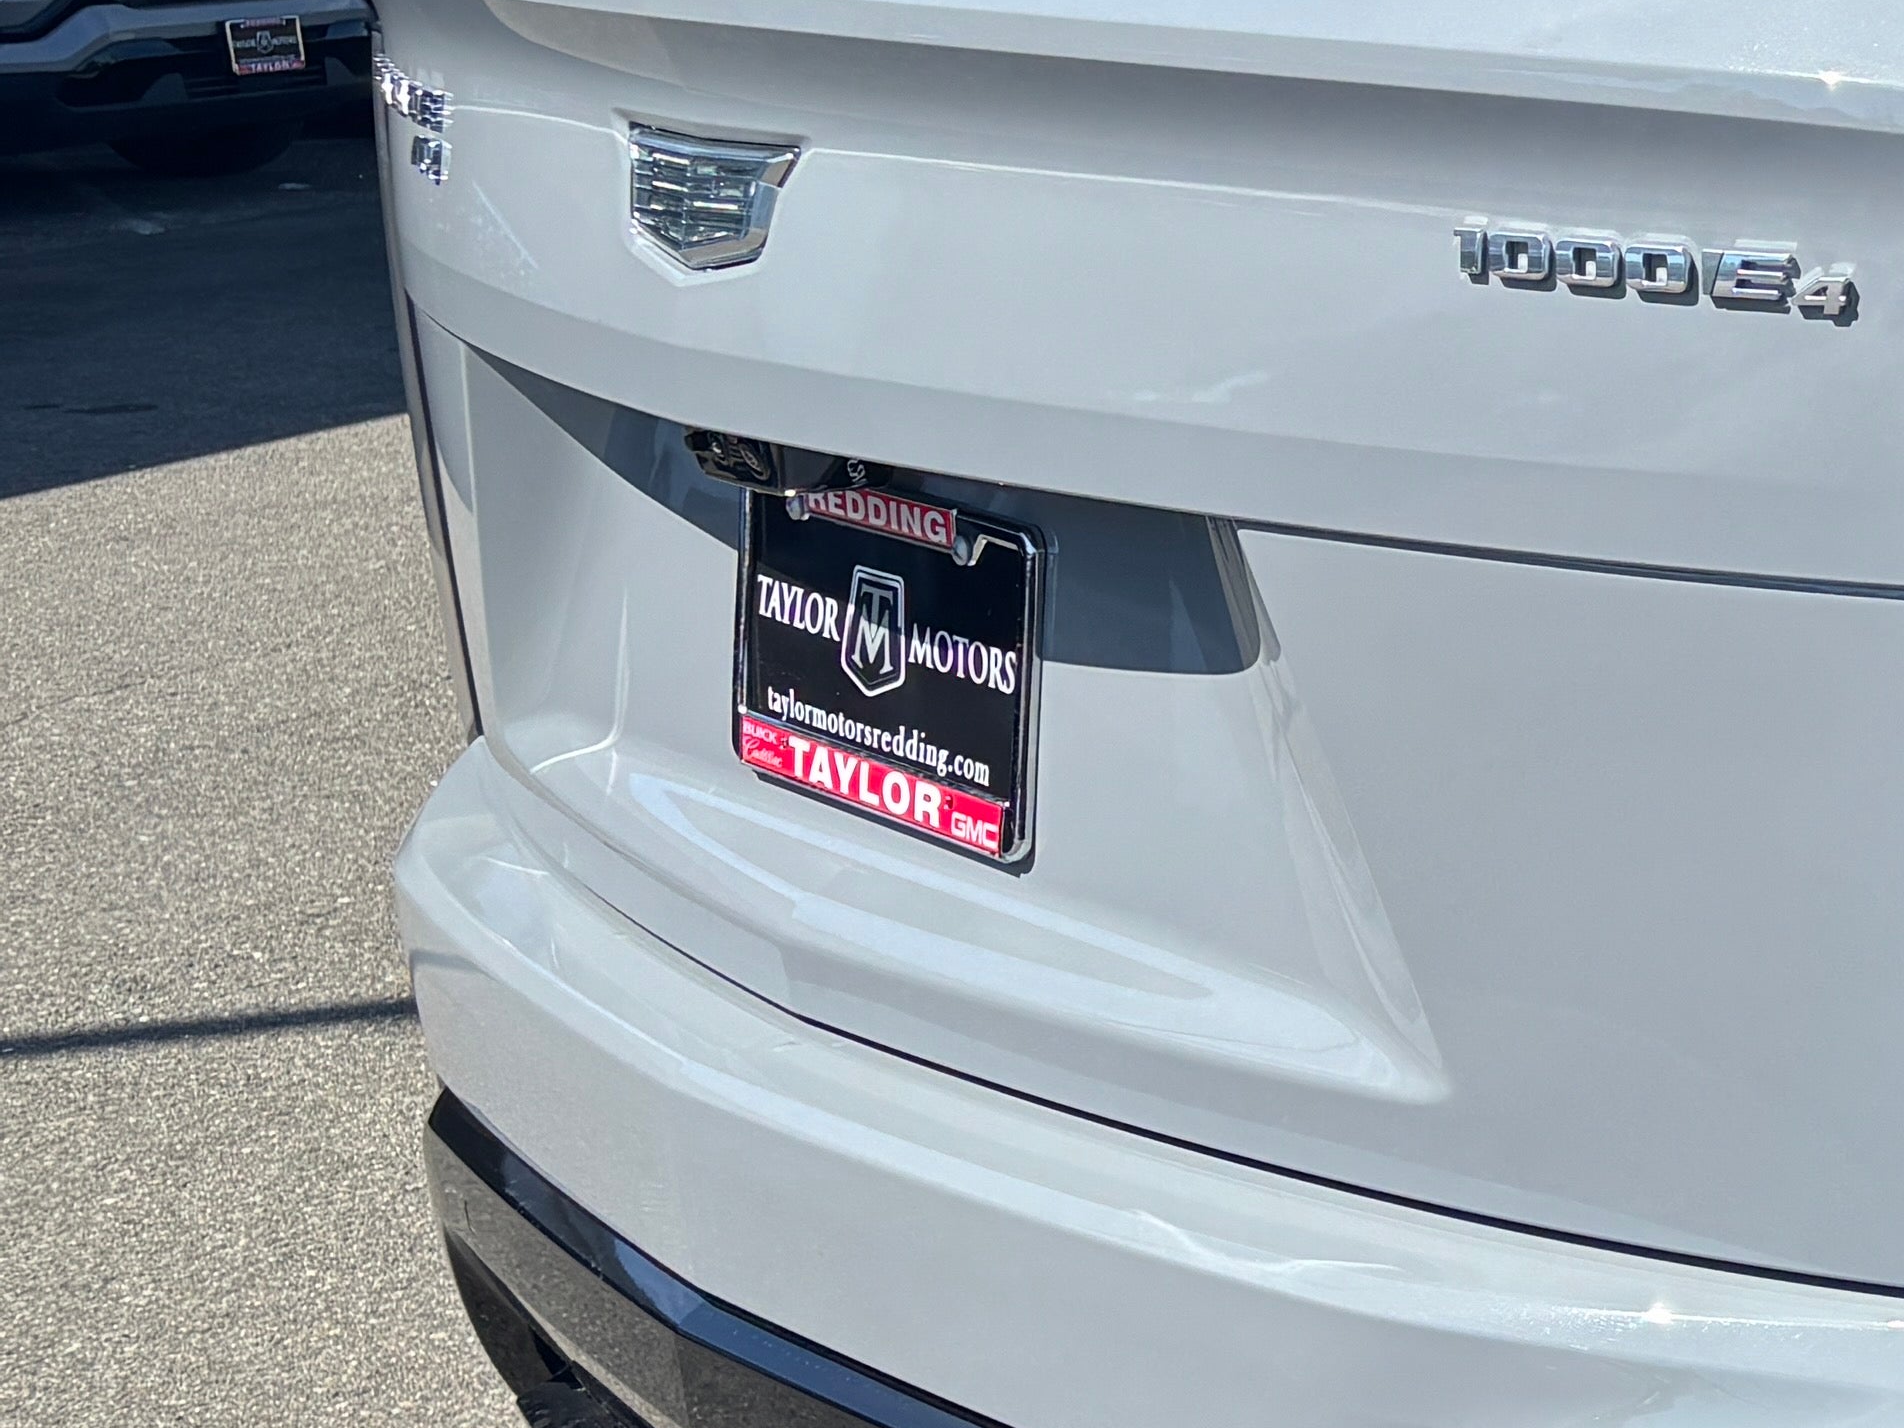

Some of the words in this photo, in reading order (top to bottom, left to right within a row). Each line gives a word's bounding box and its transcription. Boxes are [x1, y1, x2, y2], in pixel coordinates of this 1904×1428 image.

[808, 489, 948, 544] REDDING
[757, 574, 841, 642] TAYLOR
[908, 622, 1018, 695] MOTORS
[742, 720, 778, 746] BUICK
[742, 738, 783, 769] Cadillac
[767, 684, 991, 788] taylormotorsredding.com
[788, 734, 941, 829] TAYLOR
[950, 811, 1000, 850] GMC
